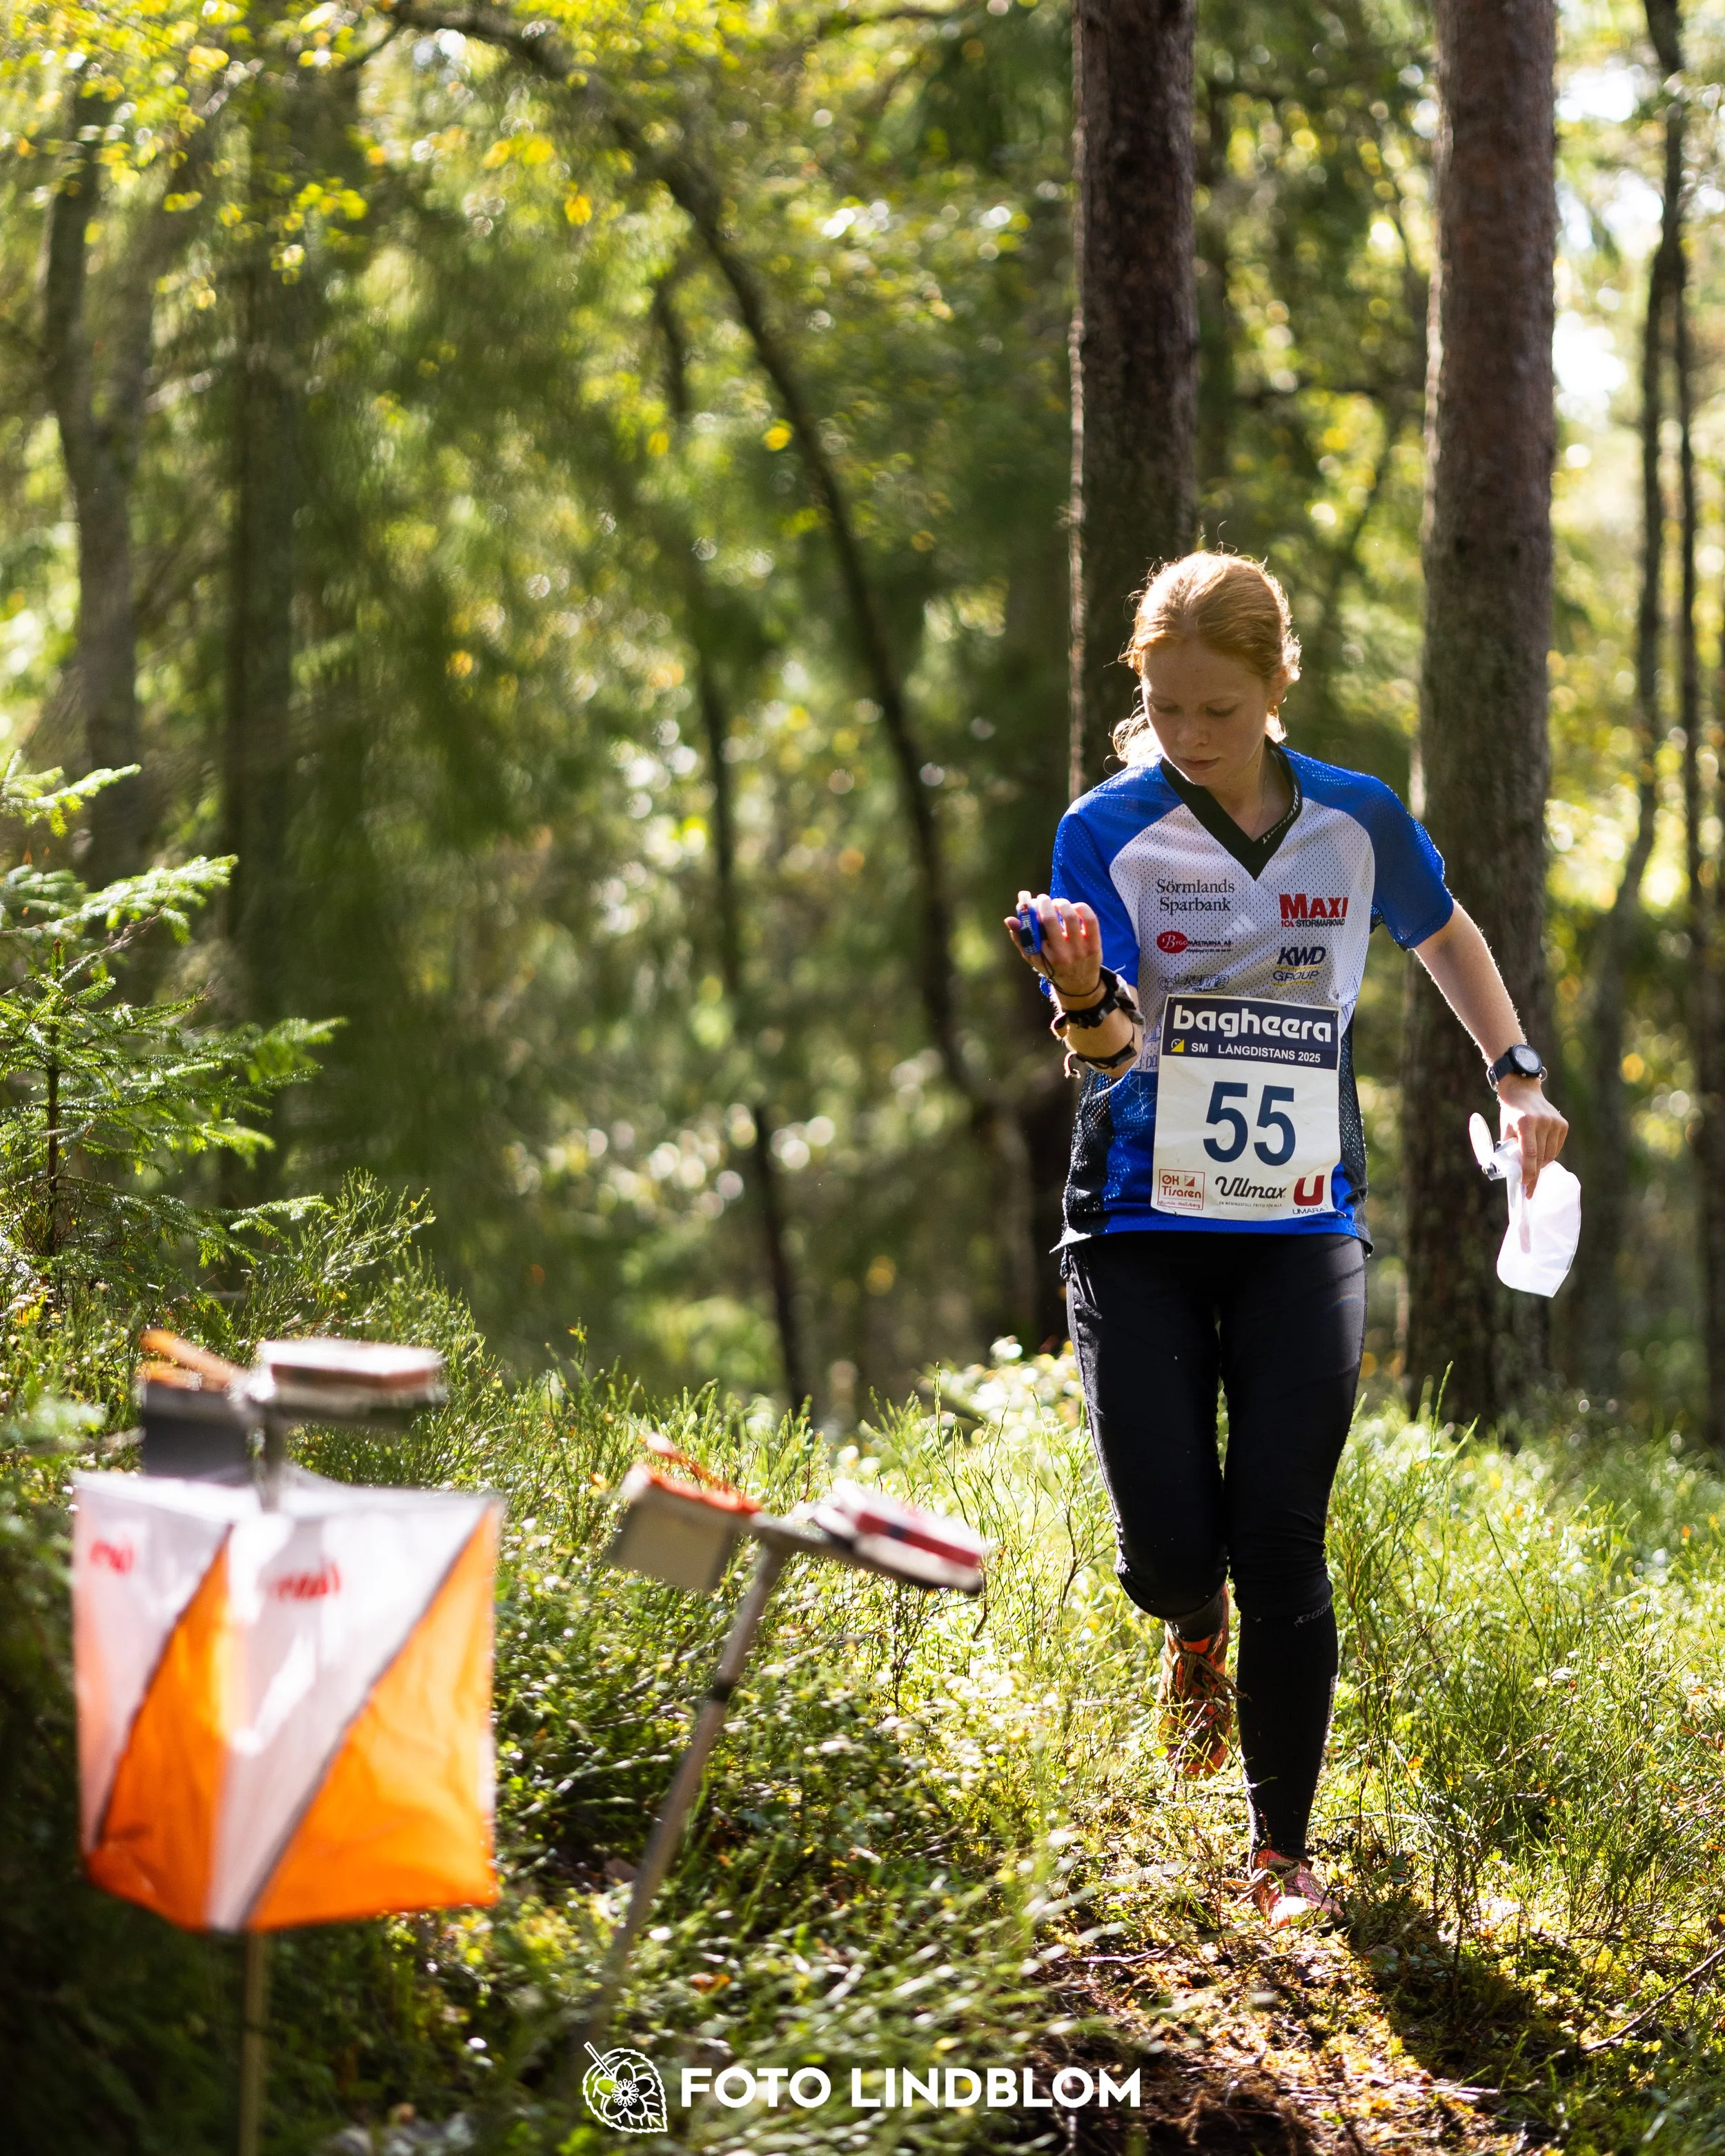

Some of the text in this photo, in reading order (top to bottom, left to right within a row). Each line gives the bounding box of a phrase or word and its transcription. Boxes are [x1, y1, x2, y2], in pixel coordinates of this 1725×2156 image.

[1156, 878, 1235, 893] Sörmlands
[1159, 897, 1231, 916] Sparbank
[1279, 893, 1349, 919] MAXI
[1296, 918, 1345, 927] STORMARKNAD
[1276, 946, 1326, 966] KWD
[1272, 970, 1319, 981] GROUP
[1173, 1005, 1331, 1042] bagheera
[1191, 1042, 1321, 1063] SM LÅNGDISTANS 2025
[1203, 1081, 1296, 1166] 55
[1162, 1185, 1201, 1198] Tisaren
[1215, 1176, 1287, 1199] Ullmax
